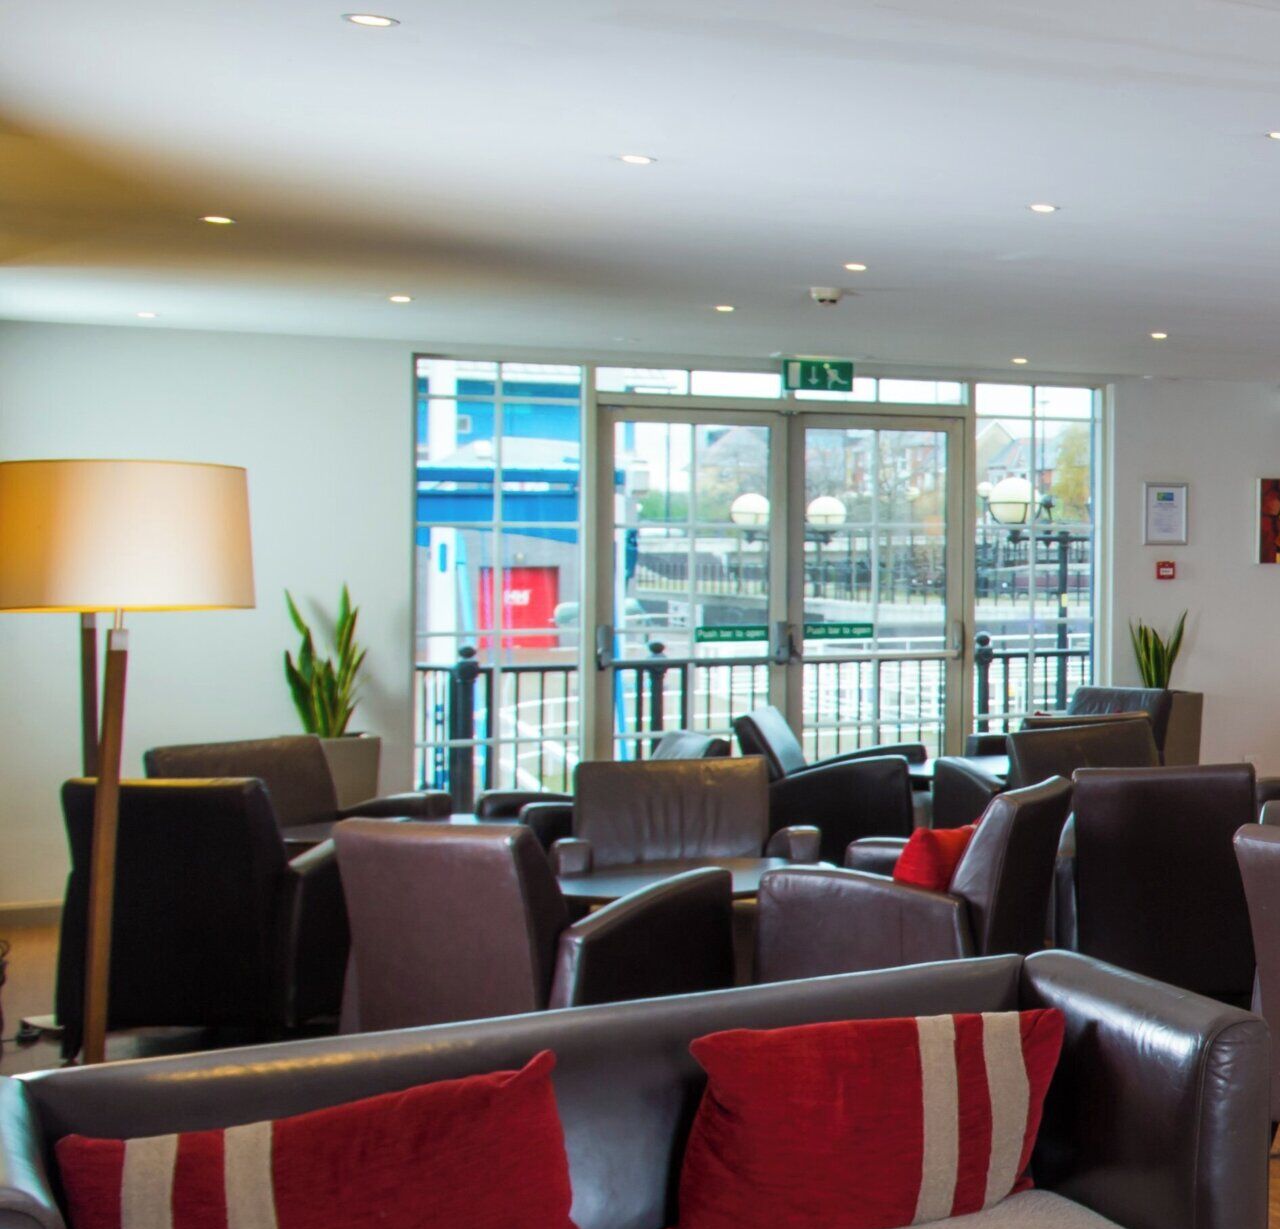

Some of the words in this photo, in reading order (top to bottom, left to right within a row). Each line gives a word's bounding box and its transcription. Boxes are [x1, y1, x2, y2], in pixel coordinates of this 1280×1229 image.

[699, 629, 717, 638] Push
[719, 629, 732, 638] bar
[735, 629, 743, 637] to
[746, 629, 766, 638] open
[806, 626, 826, 634] Push
[827, 625, 840, 634] bar
[842, 625, 850, 634] to
[852, 626, 871, 636] open
